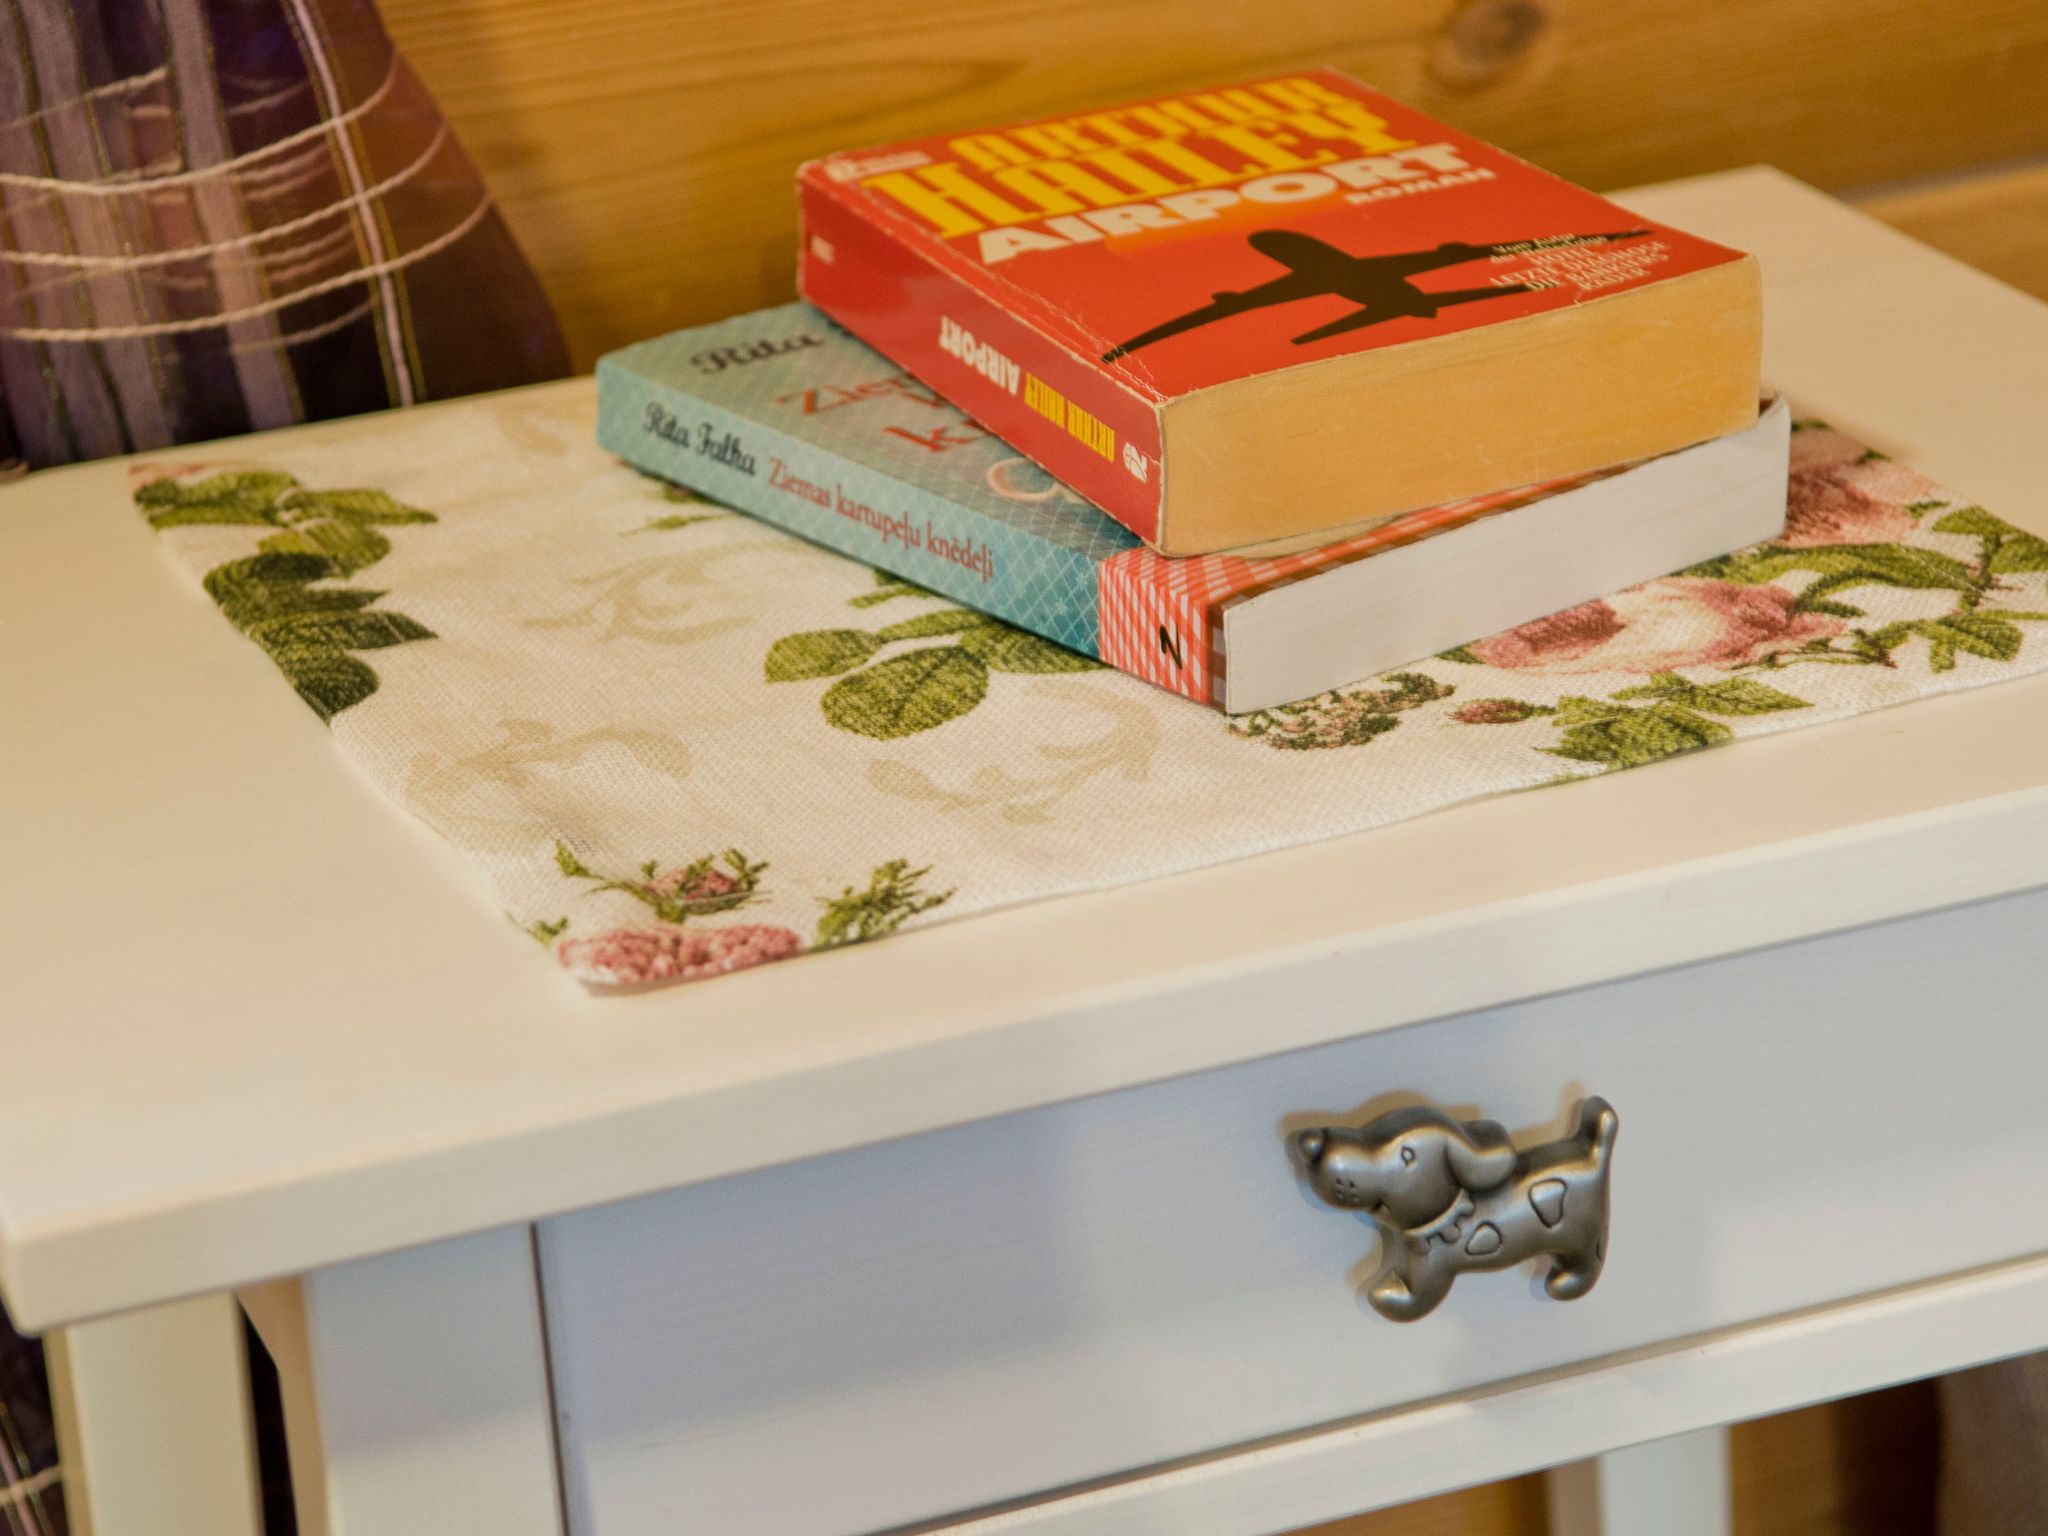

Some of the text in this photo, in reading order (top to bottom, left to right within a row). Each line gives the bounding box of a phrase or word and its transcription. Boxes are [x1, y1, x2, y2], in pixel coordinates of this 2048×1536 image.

[862, 102, 1416, 239] HAILEY
[948, 77, 1351, 173] ARTHUR
[977, 142, 1475, 265] AIRPORT
[1343, 167, 1497, 206] ROMAN
[690, 334, 824, 374] Rita
[939, 315, 1021, 396] AIRPORT
[644, 400, 690, 449] Rita
[768, 455, 832, 509] Ziemas
